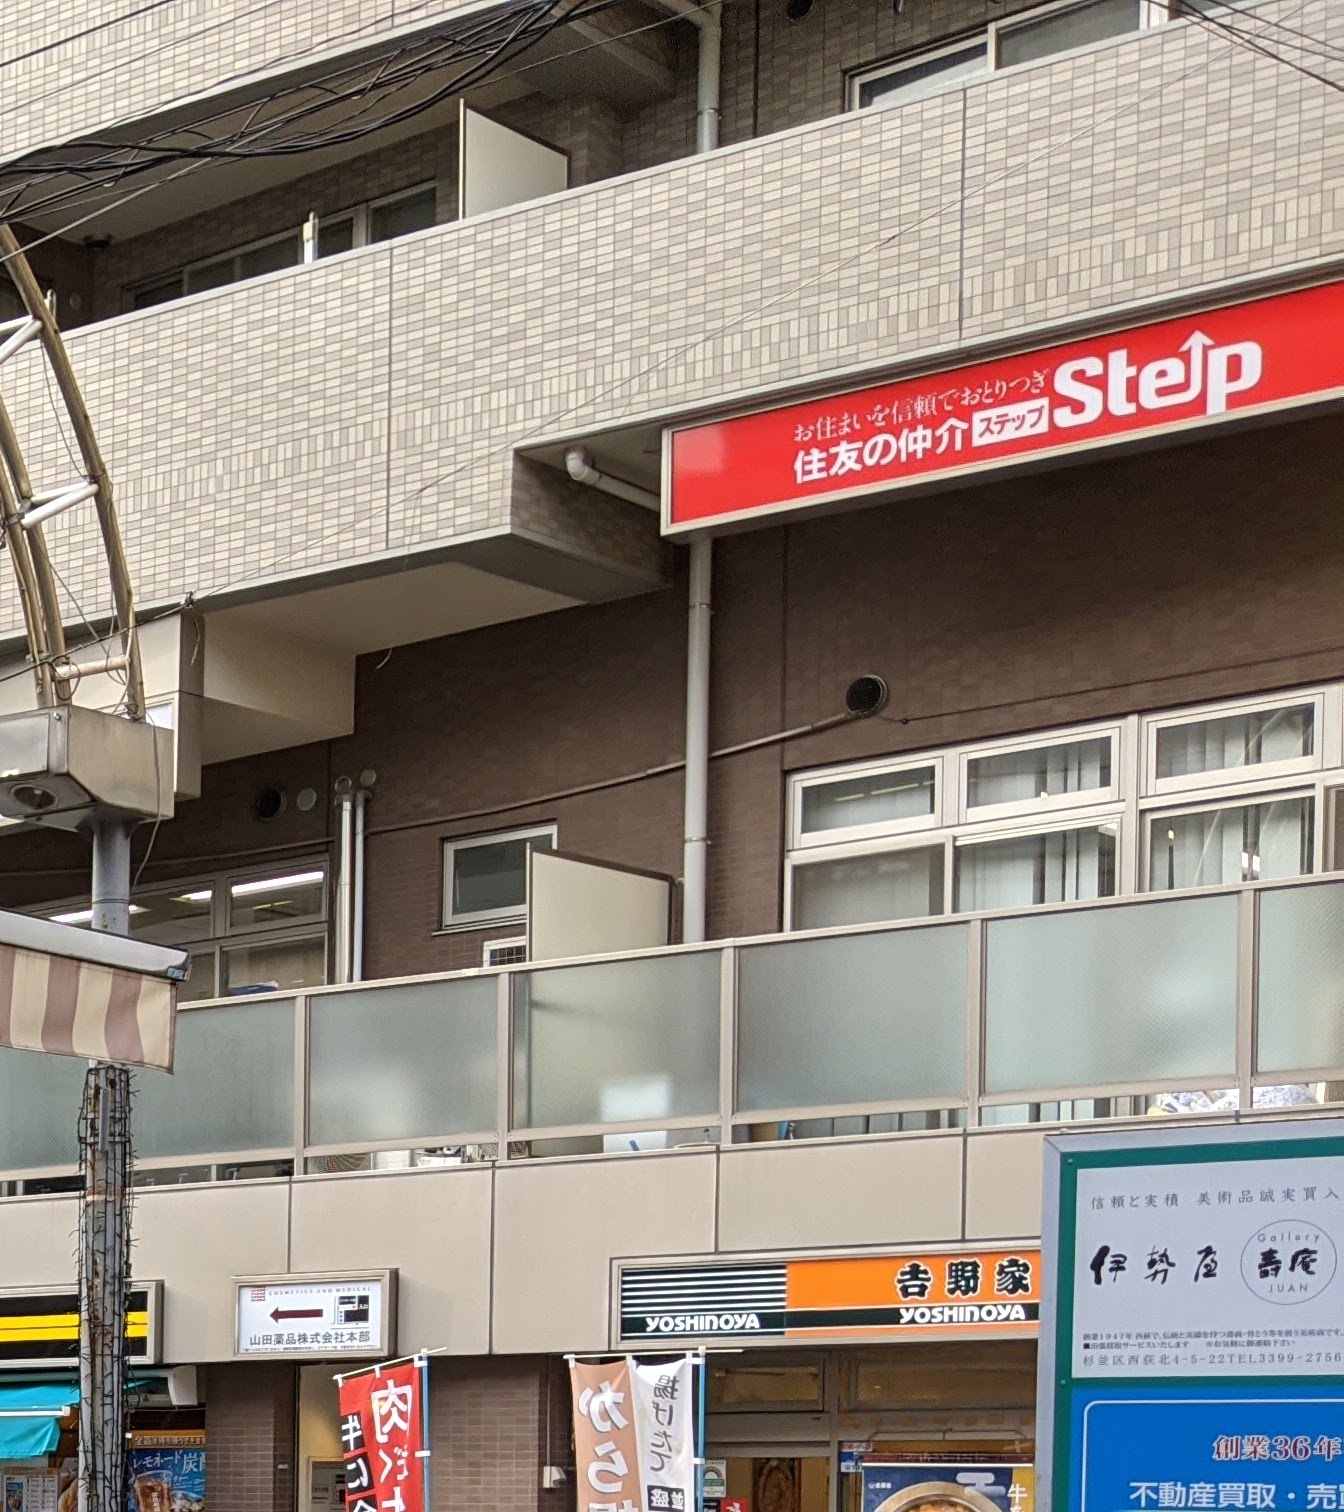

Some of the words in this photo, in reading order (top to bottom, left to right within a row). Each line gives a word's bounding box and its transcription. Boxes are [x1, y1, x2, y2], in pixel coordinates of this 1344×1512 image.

[1052, 330, 1262, 428] Step
[793, 369, 1050, 441] お住まいを信頼でおとりつぎ
[793, 418, 970, 484] 住友の仲介
[977, 405, 1046, 439] ステップ
[1257, 1231, 1321, 1243] Gallery
[895, 1258, 1032, 1299] 吉野家
[1268, 1283, 1308, 1294] JUAN
[646, 1313, 760, 1332] YOSHINOYA
[899, 1304, 1026, 1324] YOSHINOYA
[1129, 1481, 1344, 1509] 不動産買取・売
